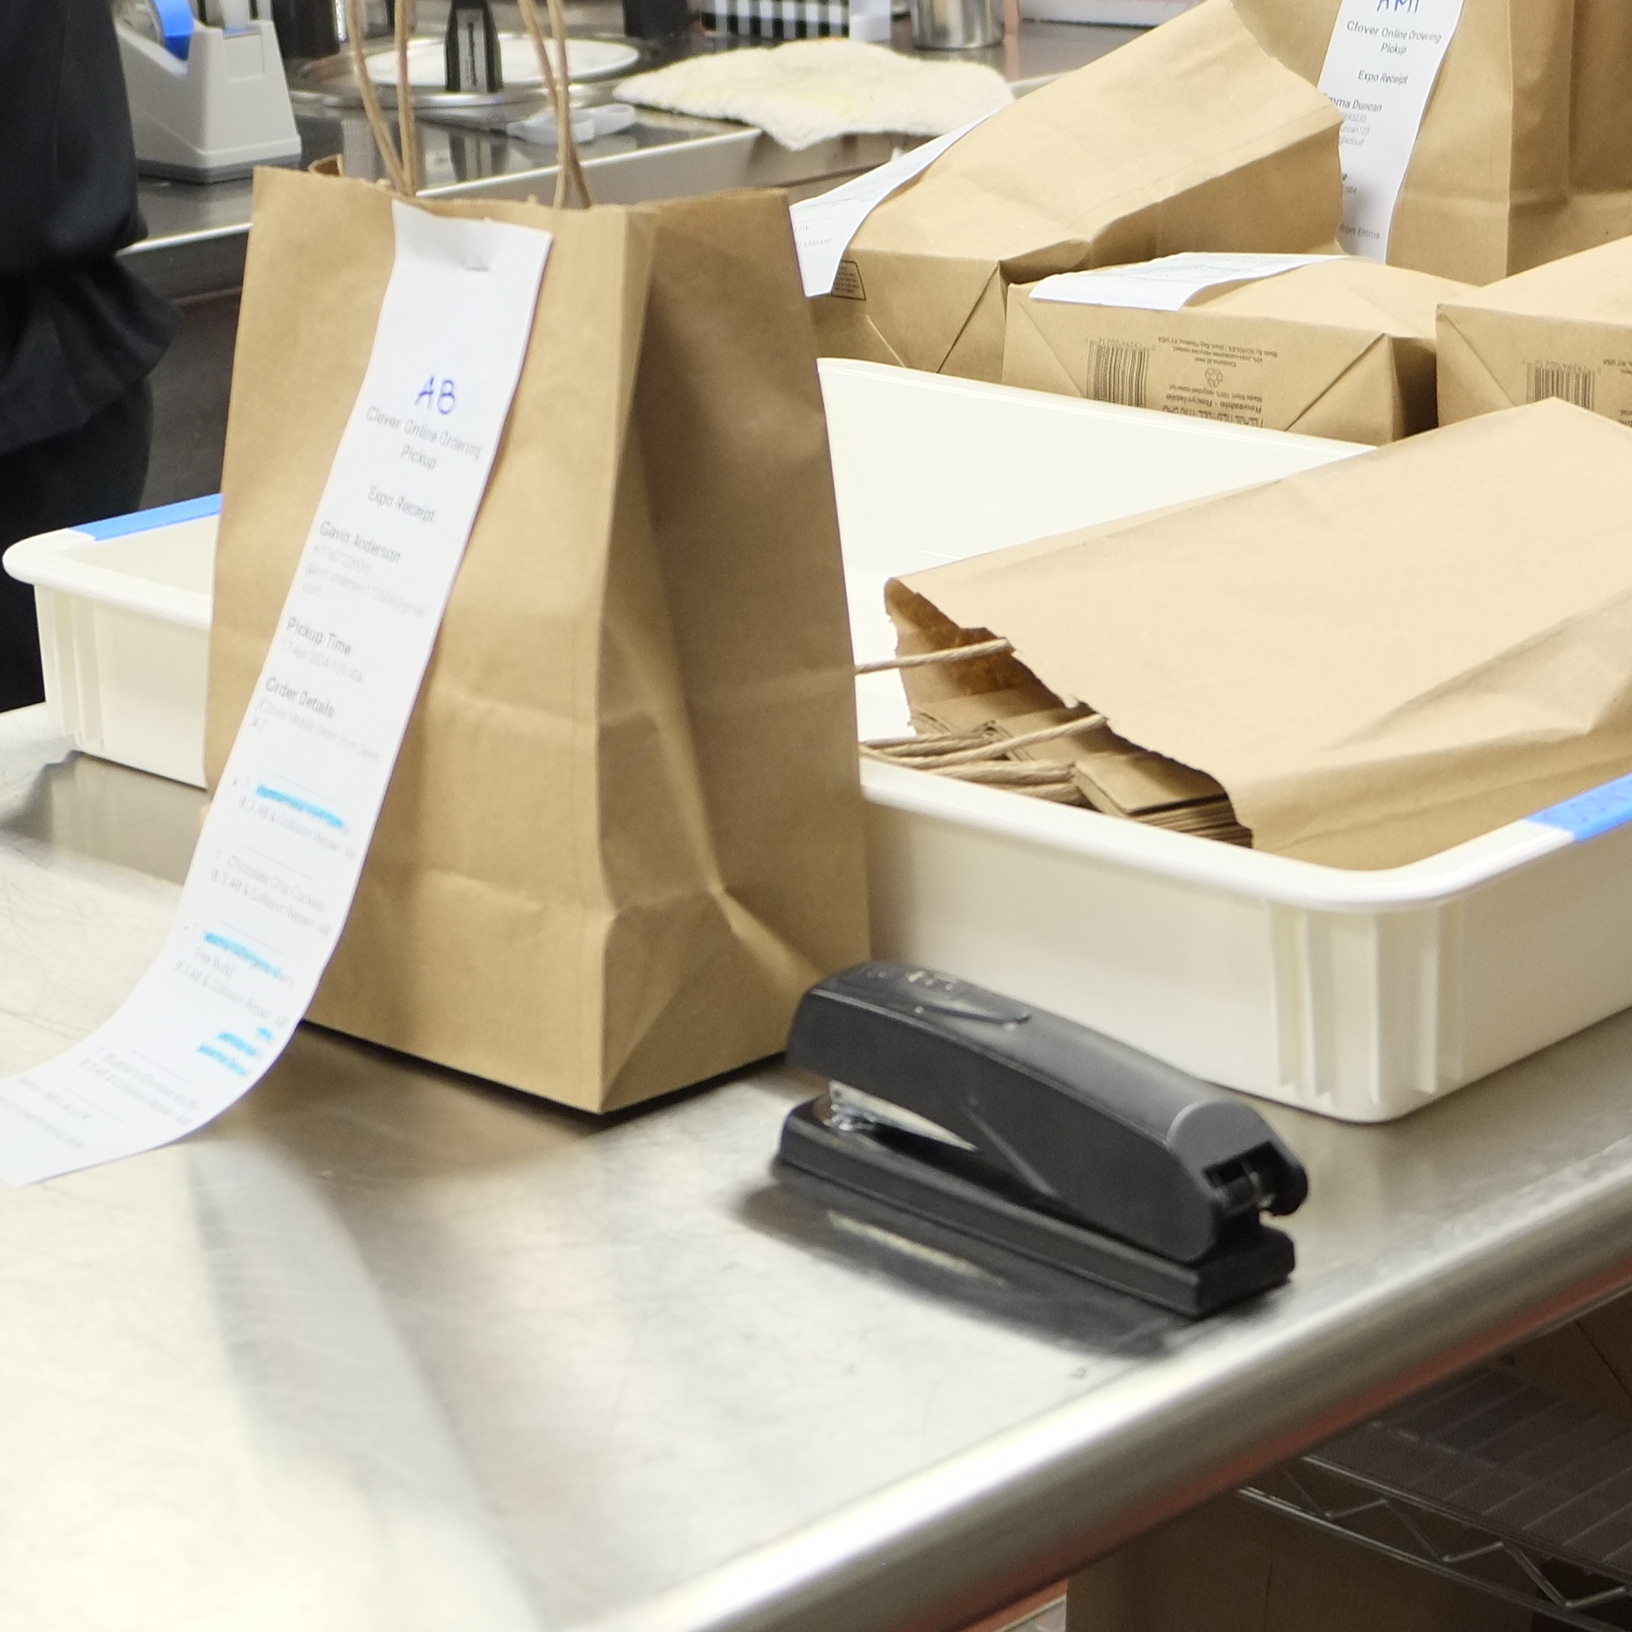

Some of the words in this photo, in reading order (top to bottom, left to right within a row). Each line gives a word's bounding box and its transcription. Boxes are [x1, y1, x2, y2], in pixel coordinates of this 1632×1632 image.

[1346, 20, 1379, 36] Clover
[1381, 27, 1407, 40] Online
[1409, 31, 1442, 44] Ordering
[1380, 43, 1407, 56] Pickup
[1358, 69, 1379, 82] Expo
[1380, 73, 1408, 85] Receipt
[1352, 100, 1382, 112] Duncan
[414, 375, 456, 415] AB
[366, 405, 402, 430] Clover
[404, 418, 438, 444] Online
[440, 431, 482, 460] Ordering
[401, 444, 437, 470] Pickup
[367, 485, 394, 509] Expo
[396, 495, 436, 524] Receipt
[319, 520, 351, 544] Gavin
[353, 532, 401, 564] Anderson
[286, 617, 324, 645] Pickup
[327, 633, 352, 656] Time
[265, 676, 299, 701] Order
[298, 691, 335, 718] Details
